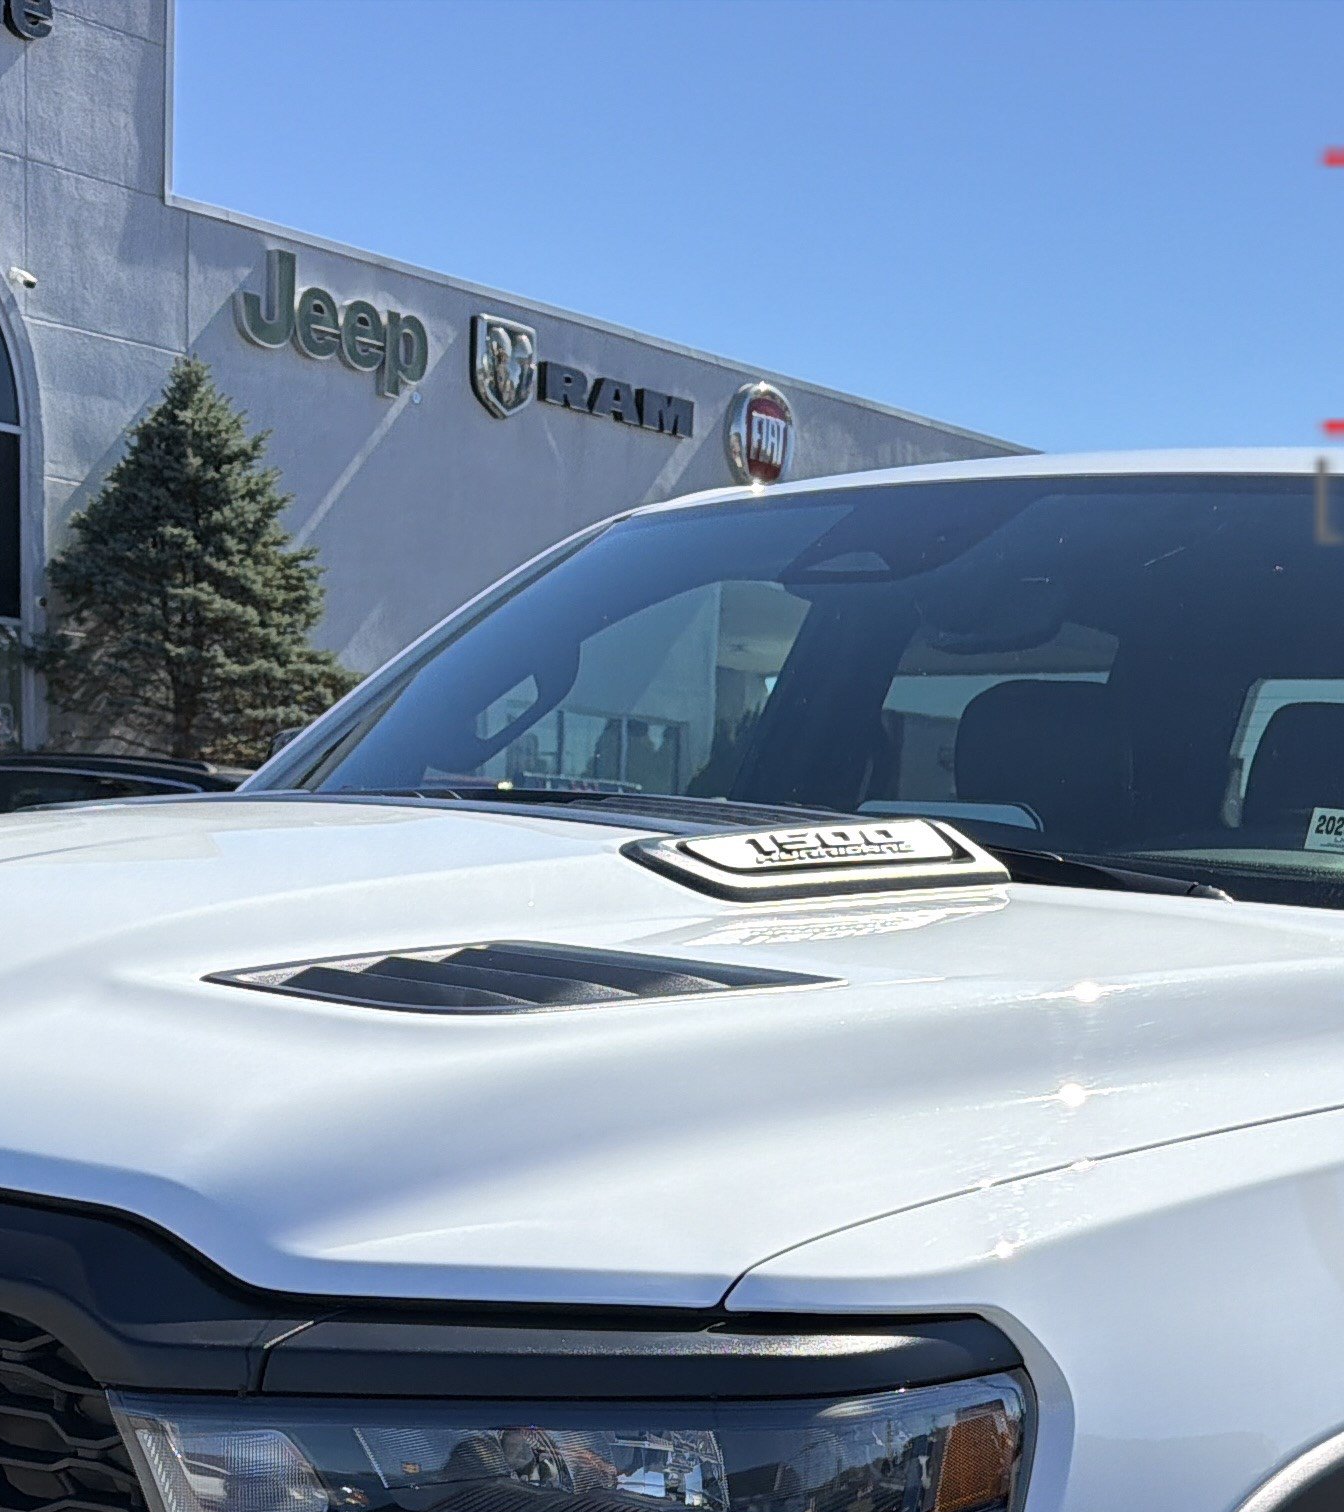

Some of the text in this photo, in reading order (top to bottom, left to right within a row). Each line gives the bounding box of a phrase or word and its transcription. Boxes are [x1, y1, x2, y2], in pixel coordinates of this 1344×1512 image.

[233, 249, 428, 398] Jeep
[537, 360, 695, 439] RAM
[749, 409, 786, 466] FIAT
[745, 828, 905, 856] 1500
